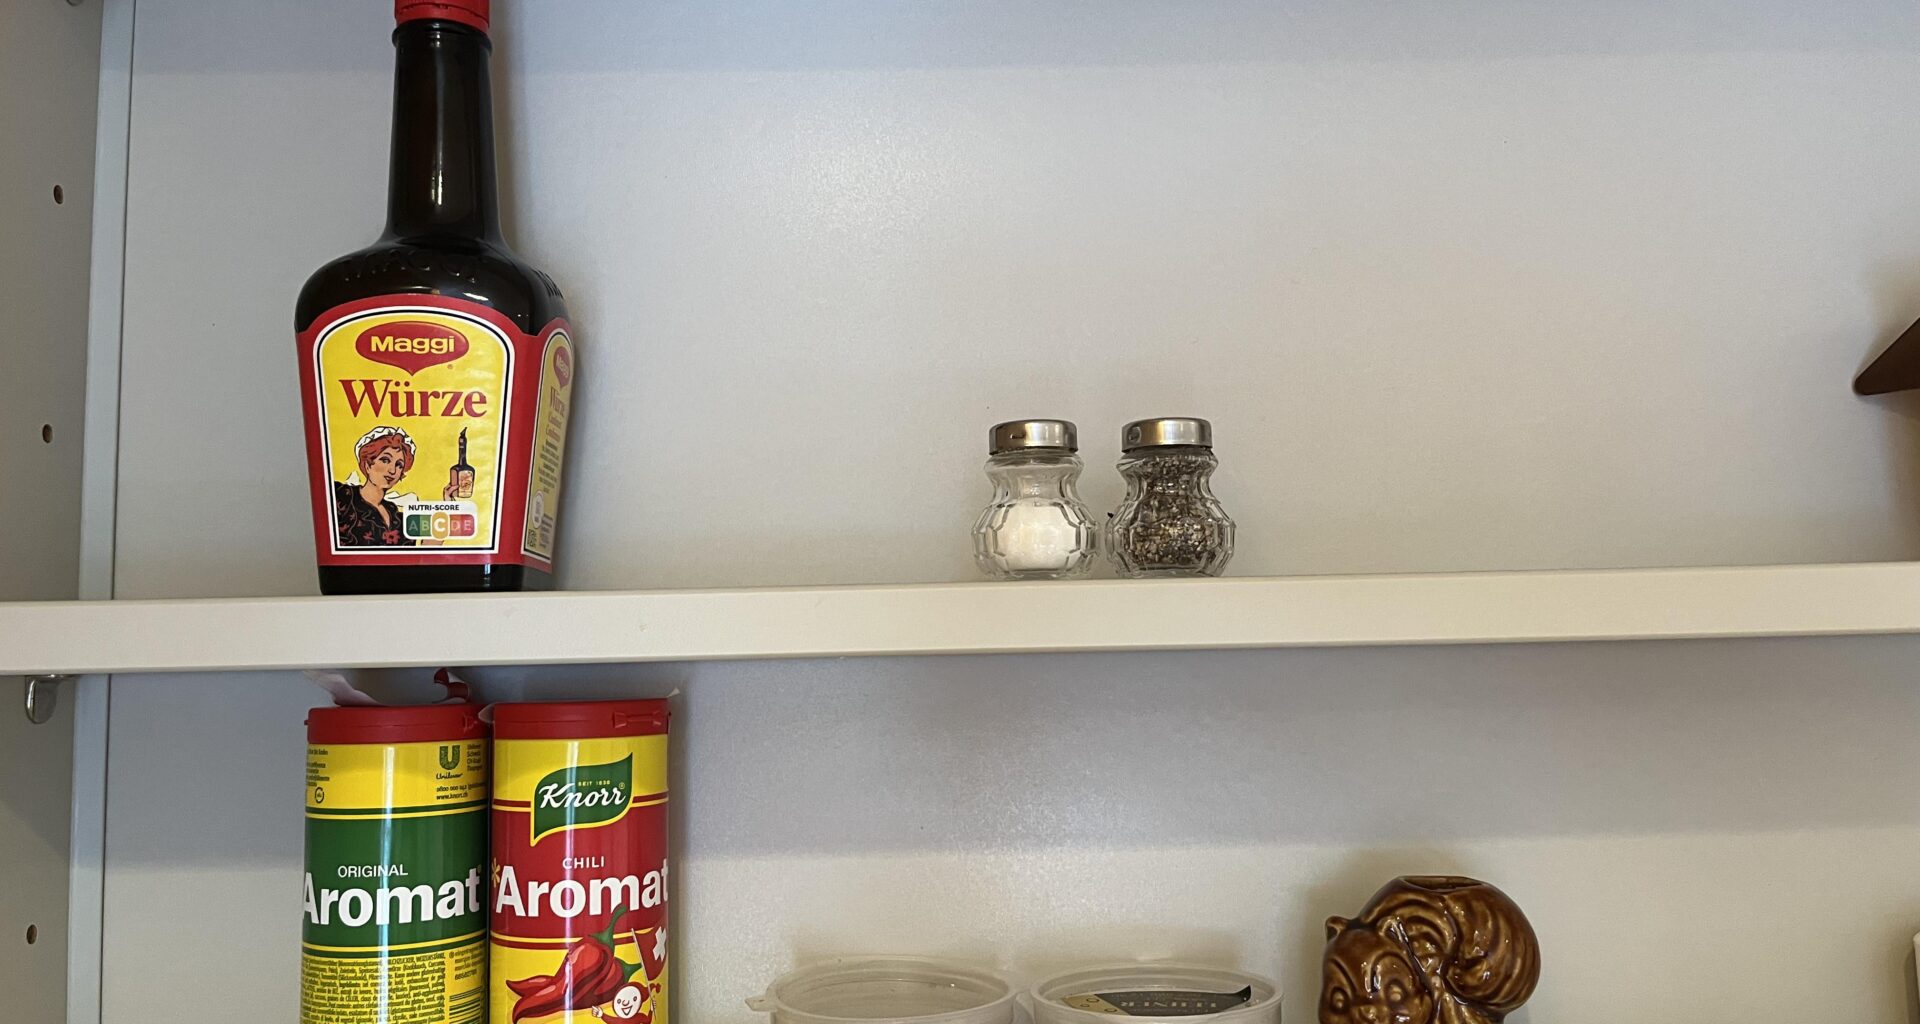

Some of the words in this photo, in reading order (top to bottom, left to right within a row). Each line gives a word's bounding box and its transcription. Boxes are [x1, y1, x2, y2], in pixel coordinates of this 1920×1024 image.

[371, 335, 456, 355] Maggi
[338, 379, 488, 418] Würze
[538, 783, 627, 809] Knorr
[337, 864, 409, 878] ORIGINAL
[562, 856, 605, 870] CHILI
[302, 868, 481, 927] Aromat
[495, 858, 669, 918] Aromat
